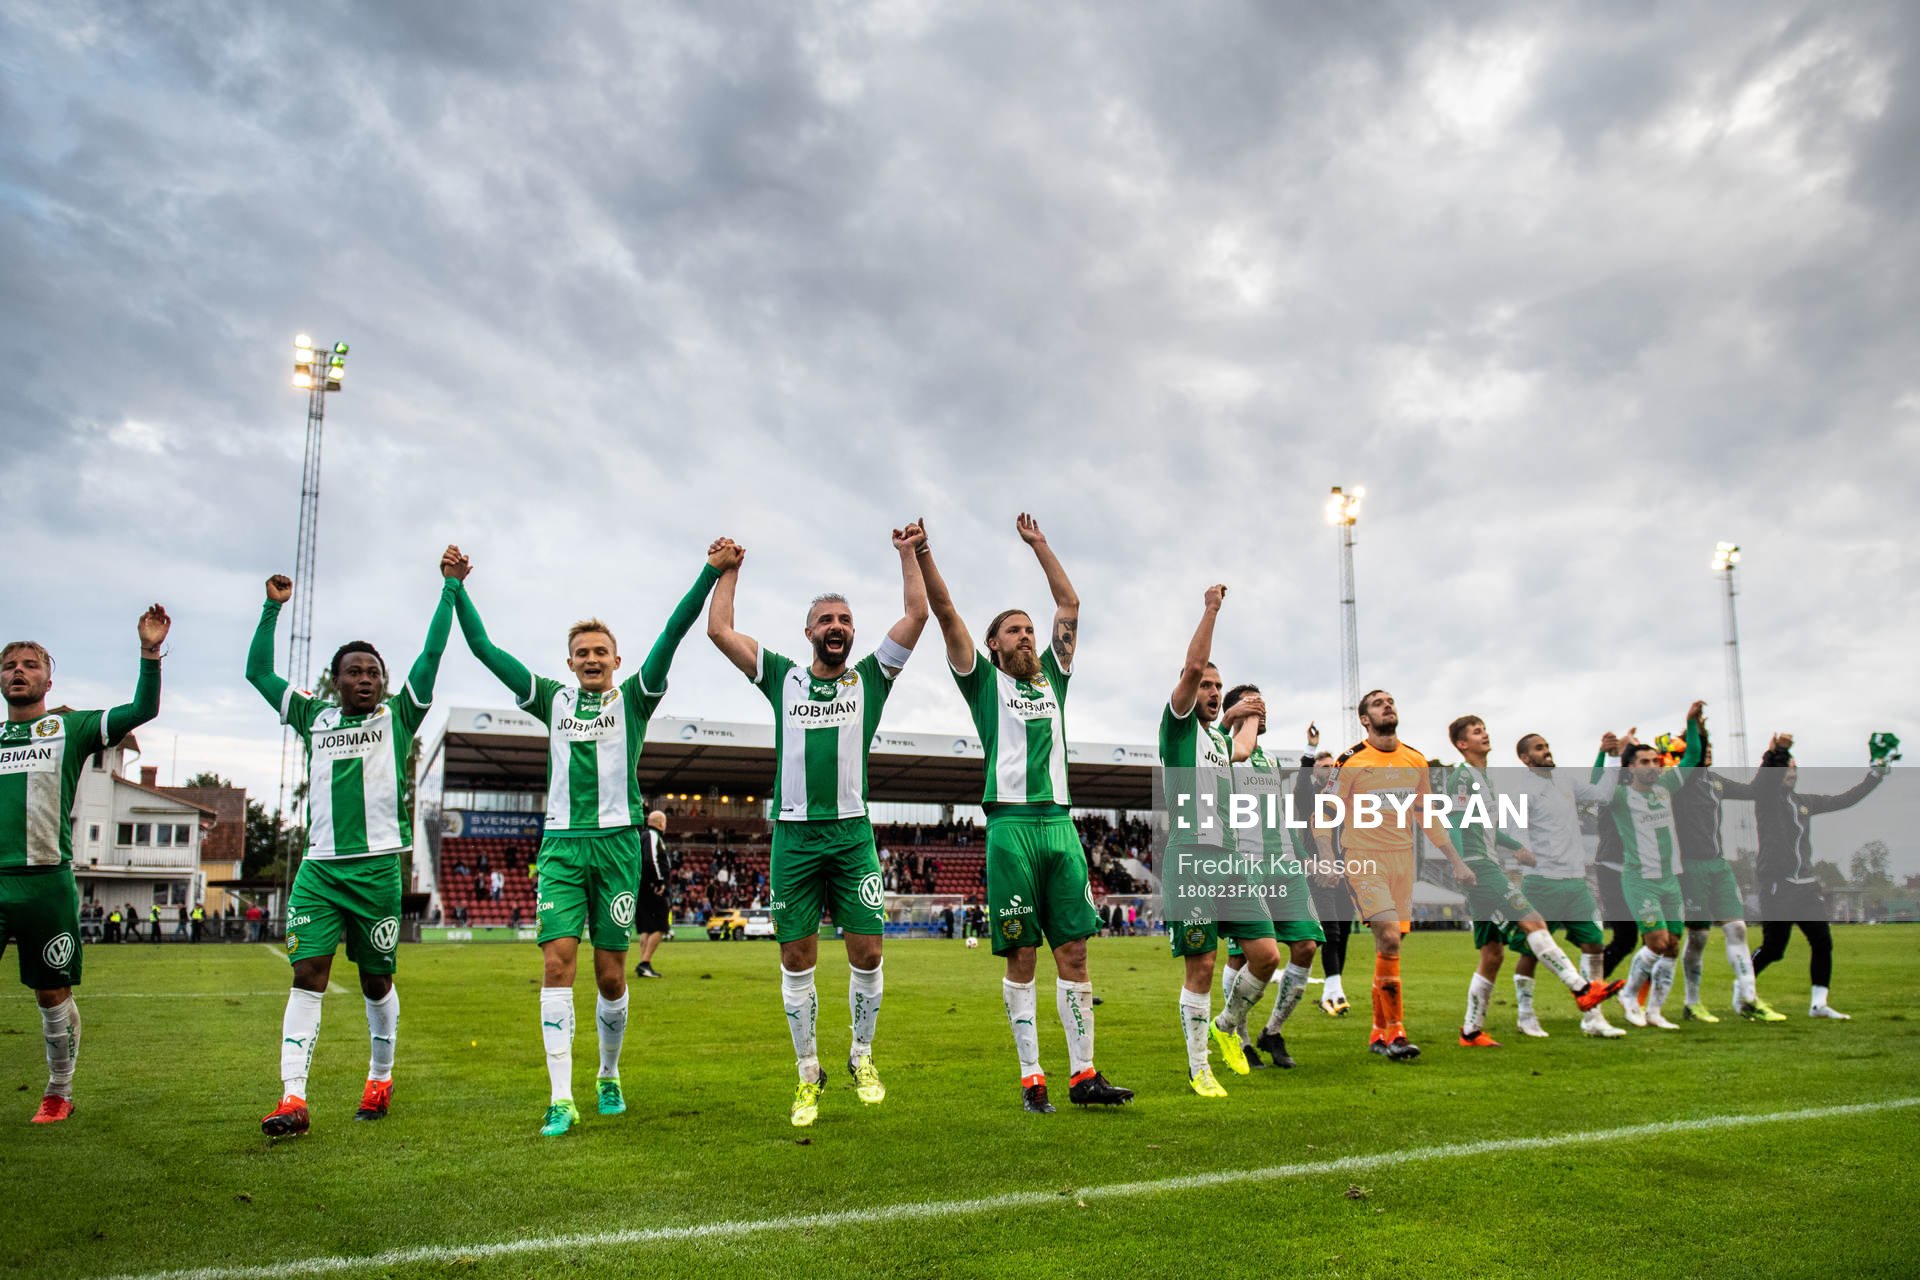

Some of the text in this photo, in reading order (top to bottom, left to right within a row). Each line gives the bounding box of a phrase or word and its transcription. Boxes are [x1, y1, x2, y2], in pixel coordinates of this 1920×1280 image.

[789, 700, 857, 718] JOBMAN
[557, 715, 615, 732] JOBMAN
[318, 730, 383, 749] JOBMAN
[702, 730, 735, 738] TRYSIL
[0, 748, 52, 763] BMAN
[471, 815, 539, 826] SVENSKA
[471, 826, 518, 835] SKYLTAR
